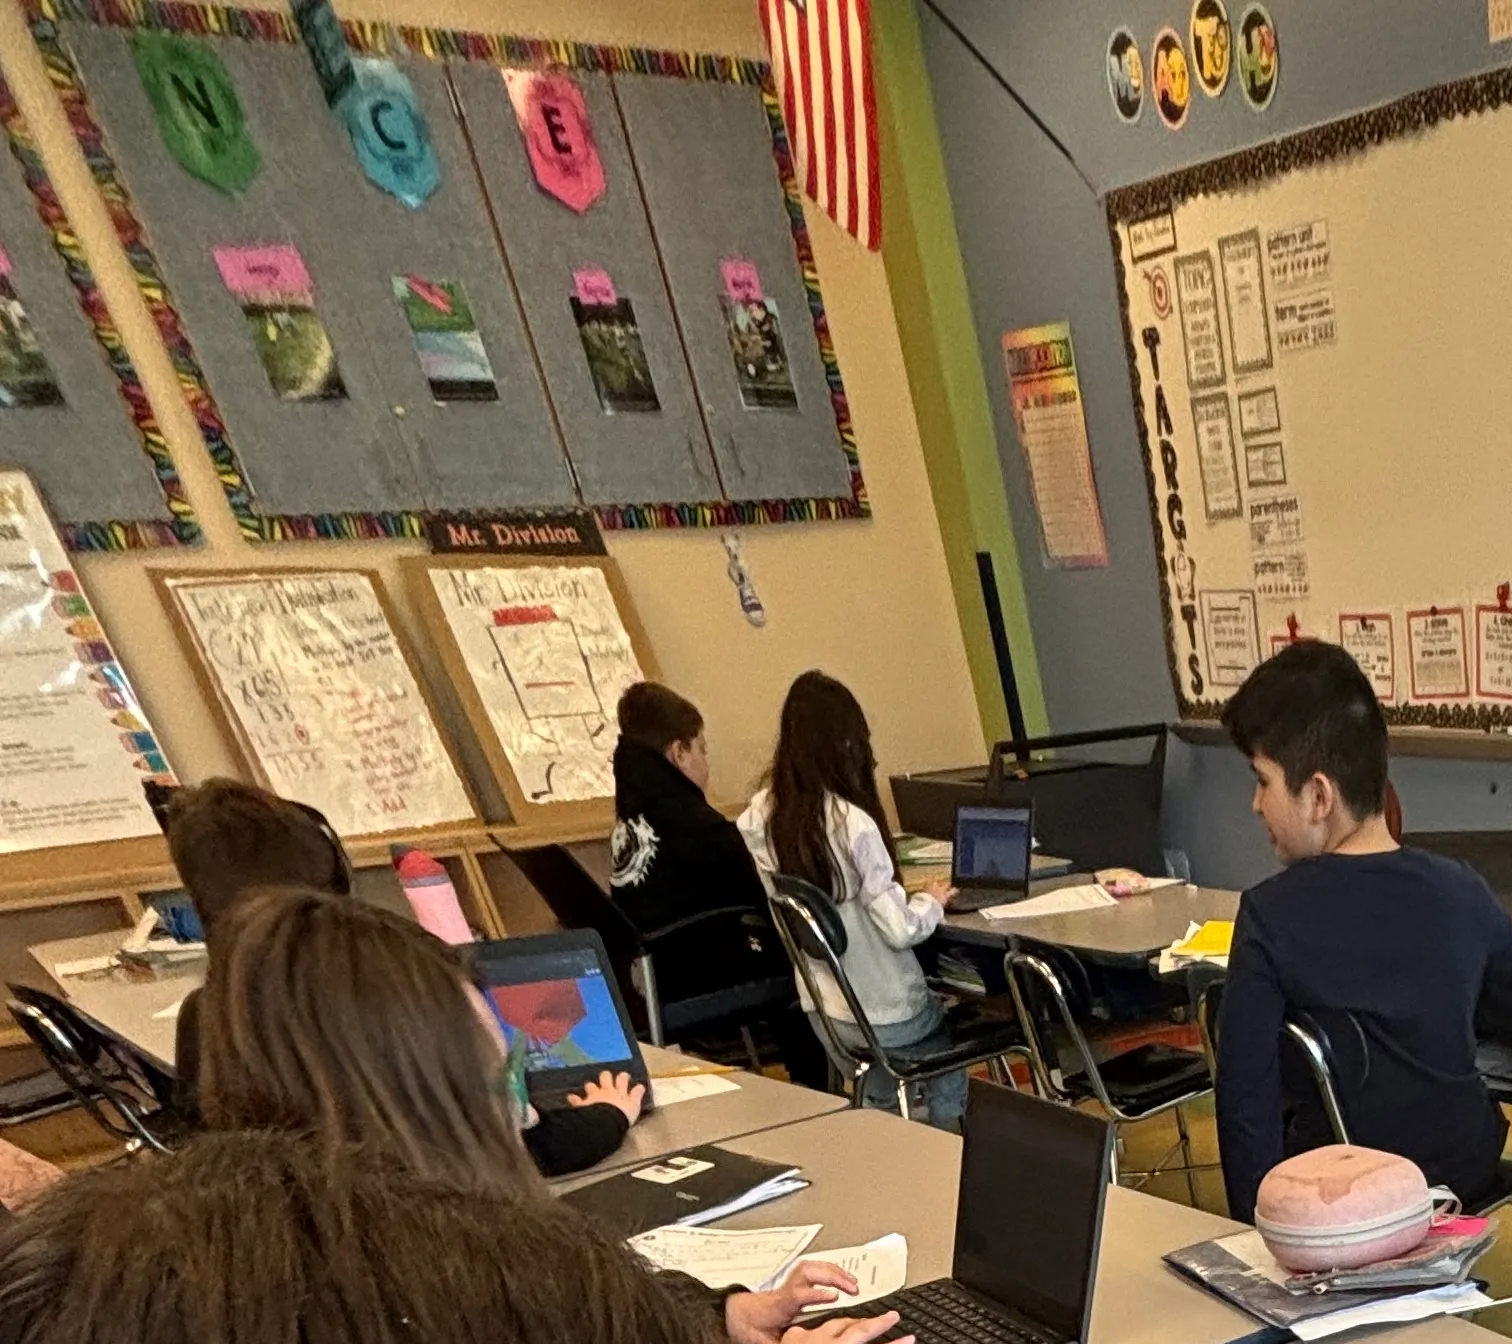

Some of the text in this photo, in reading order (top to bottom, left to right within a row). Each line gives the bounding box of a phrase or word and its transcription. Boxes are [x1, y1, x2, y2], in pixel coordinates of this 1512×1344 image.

[447, 523, 581, 548] Mr. Division
[496, 571, 589, 604] Division
